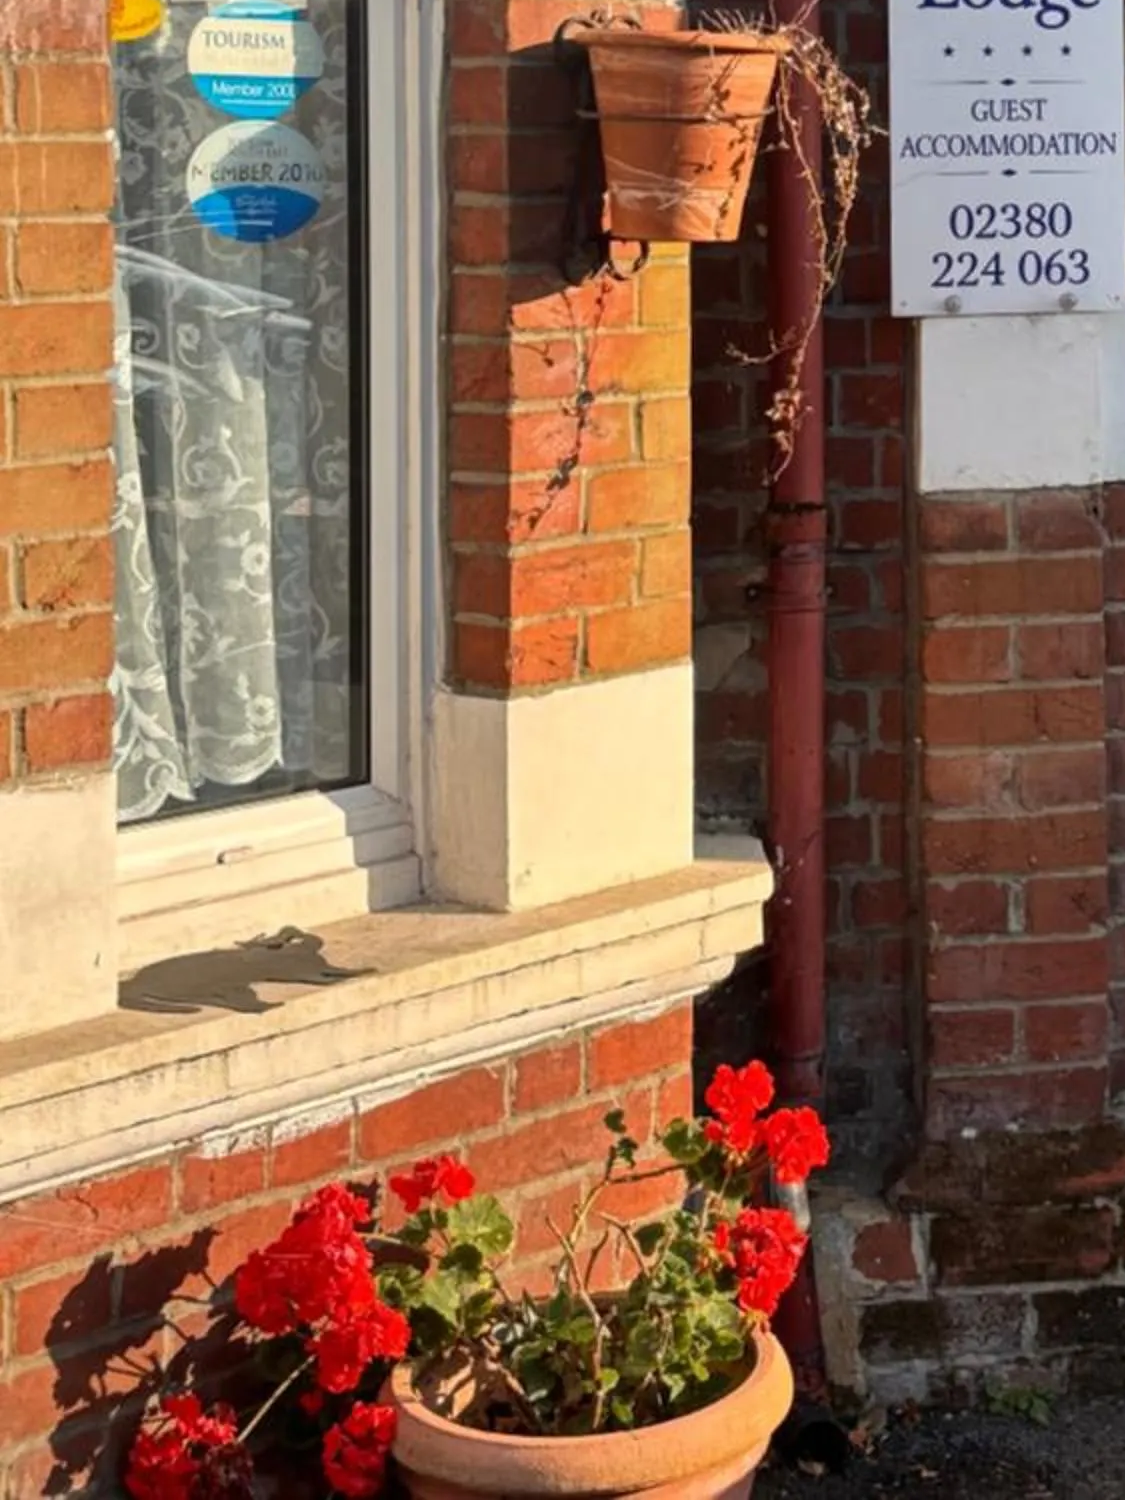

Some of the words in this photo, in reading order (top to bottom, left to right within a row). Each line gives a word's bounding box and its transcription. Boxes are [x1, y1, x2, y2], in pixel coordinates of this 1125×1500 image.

[202, 29, 286, 51] TOURISM
[970, 98, 1048, 123] GUEST
[899, 131, 1118, 159] ACCOMMODATION
[949, 201, 1073, 240] 02380
[930, 251, 1006, 288] 224
[1017, 248, 1091, 286] 063
